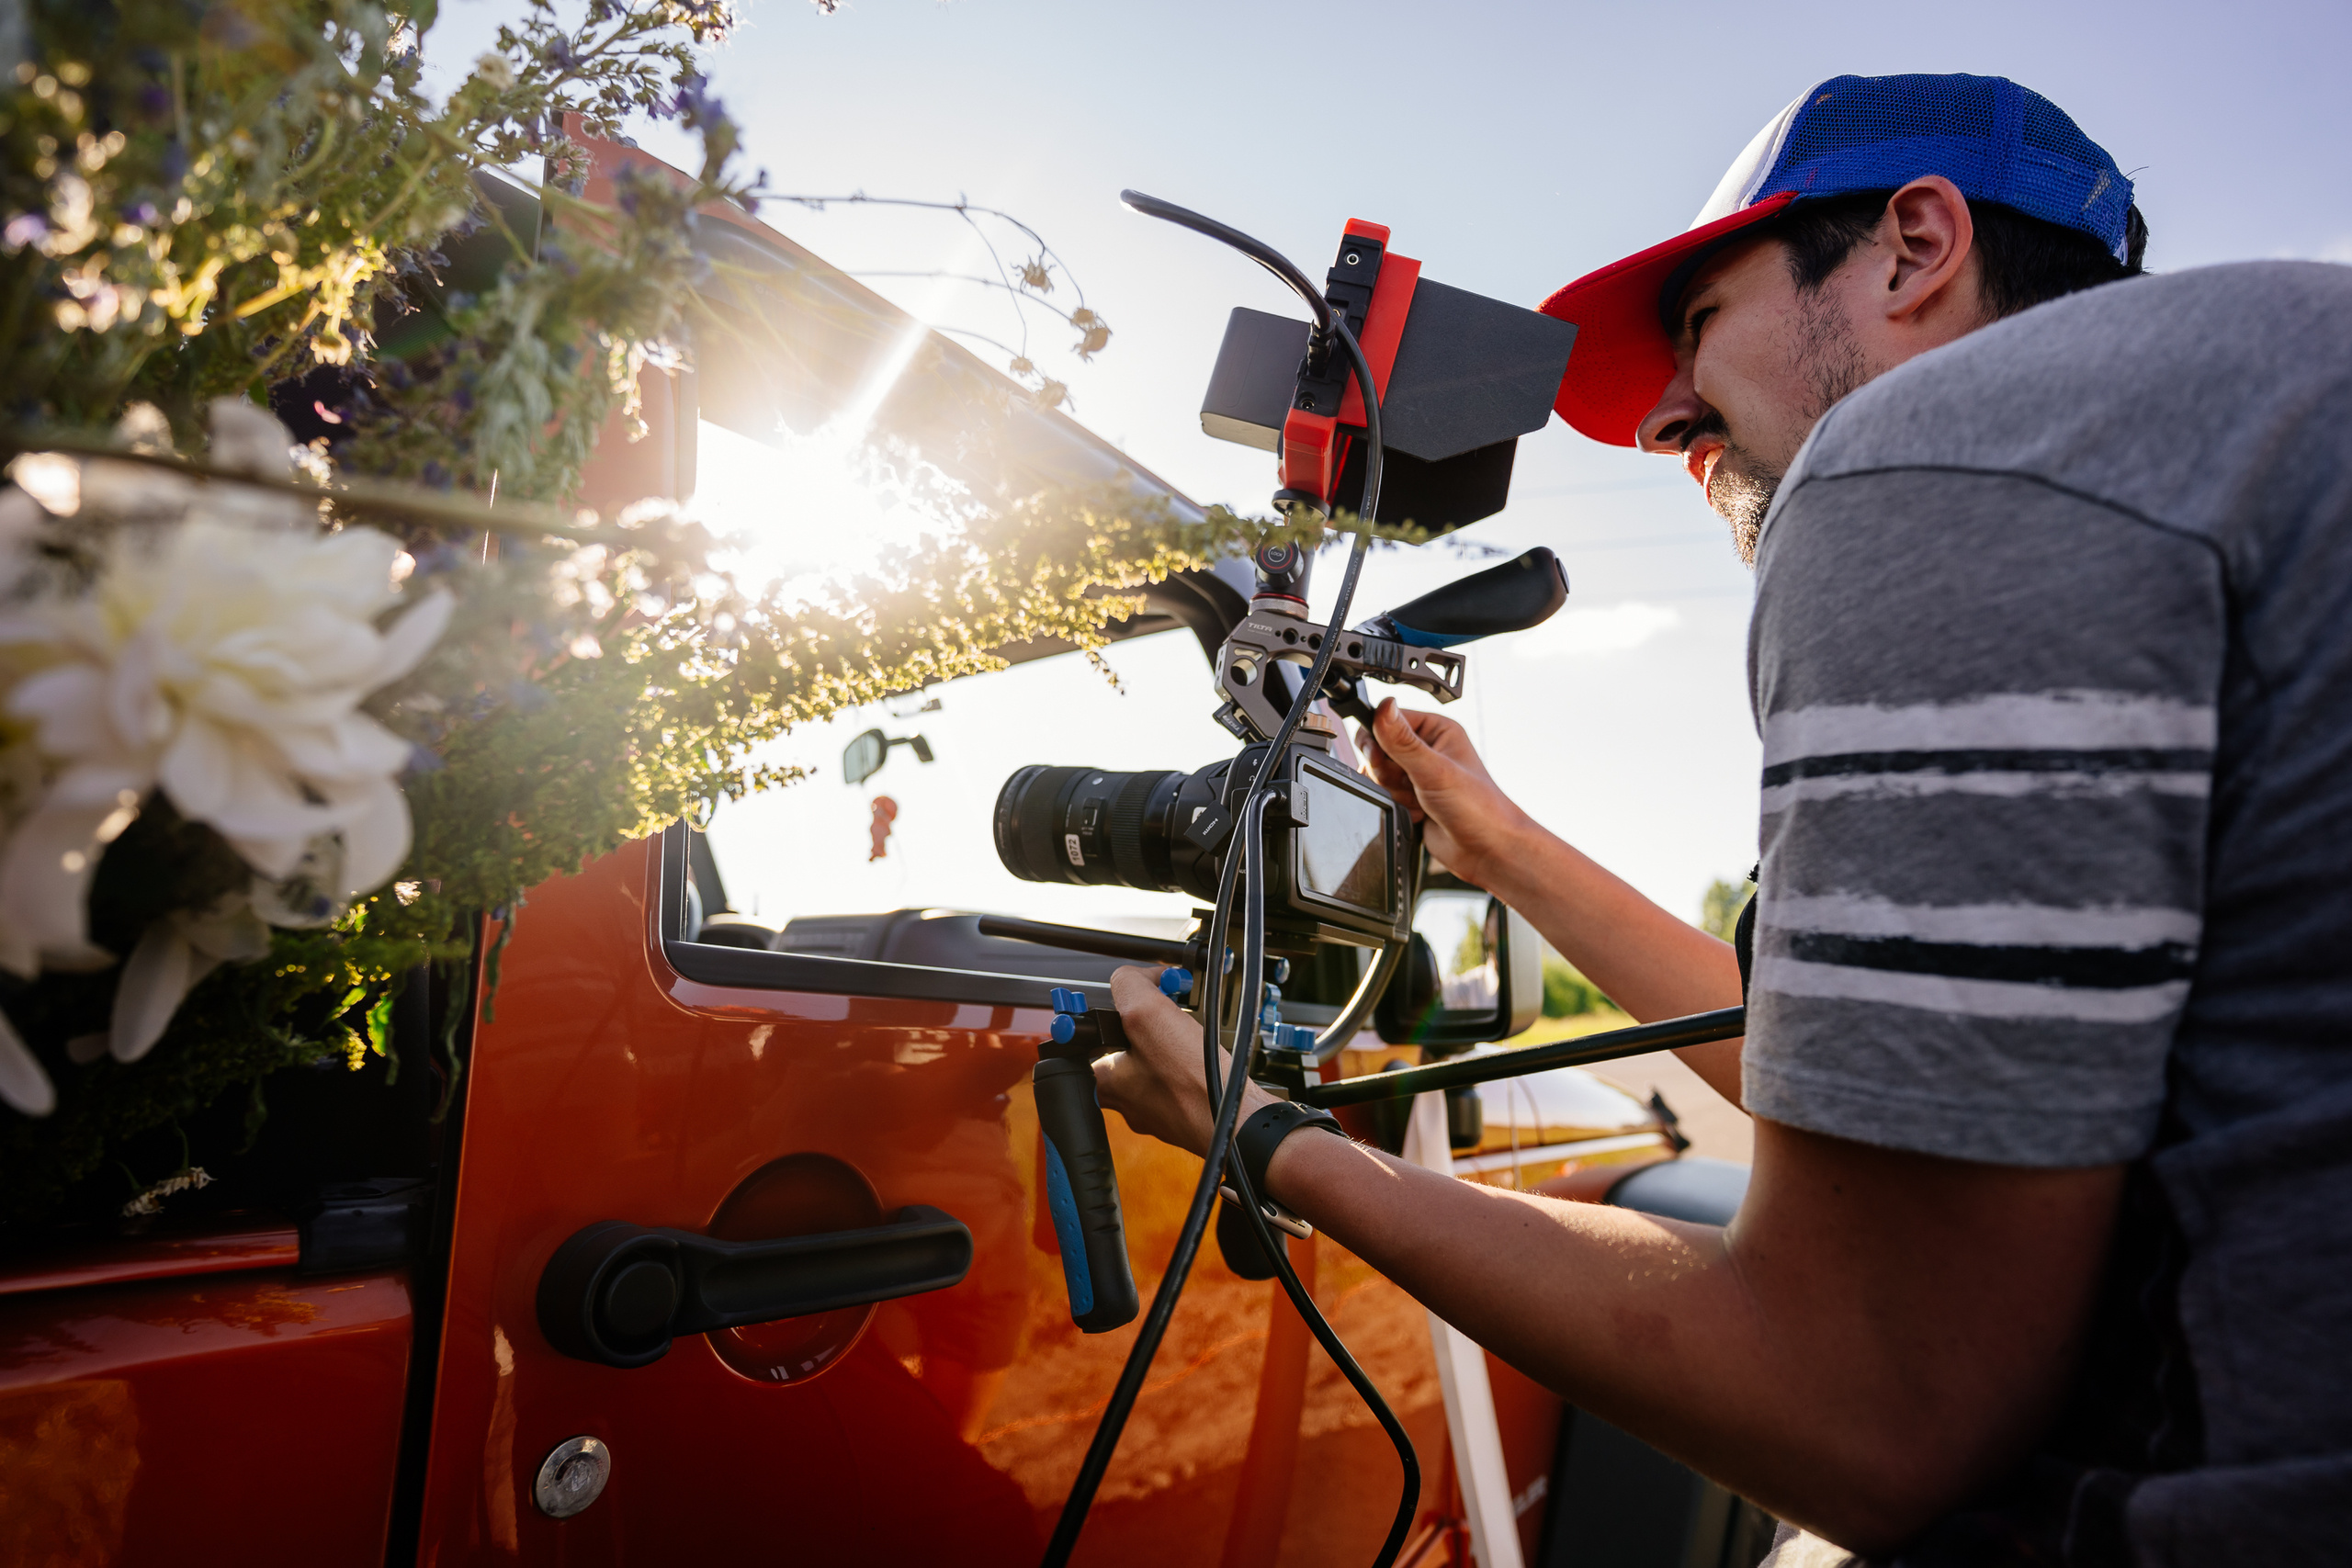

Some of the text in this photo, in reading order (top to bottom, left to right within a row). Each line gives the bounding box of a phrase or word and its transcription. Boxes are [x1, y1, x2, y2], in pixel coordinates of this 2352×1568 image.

[1249, 622, 1272, 632] TILTA
[1297, 705, 1306, 719] HIGH
[1307, 680, 1318, 700] SPEED
[1329, 627, 1339, 648] CABLE
[1344, 581, 1352, 601] STYLE
[1222, 715, 1240, 731] TILTA
[1203, 818, 1218, 836] HDMI
[1069, 839, 1080, 861] 1072
